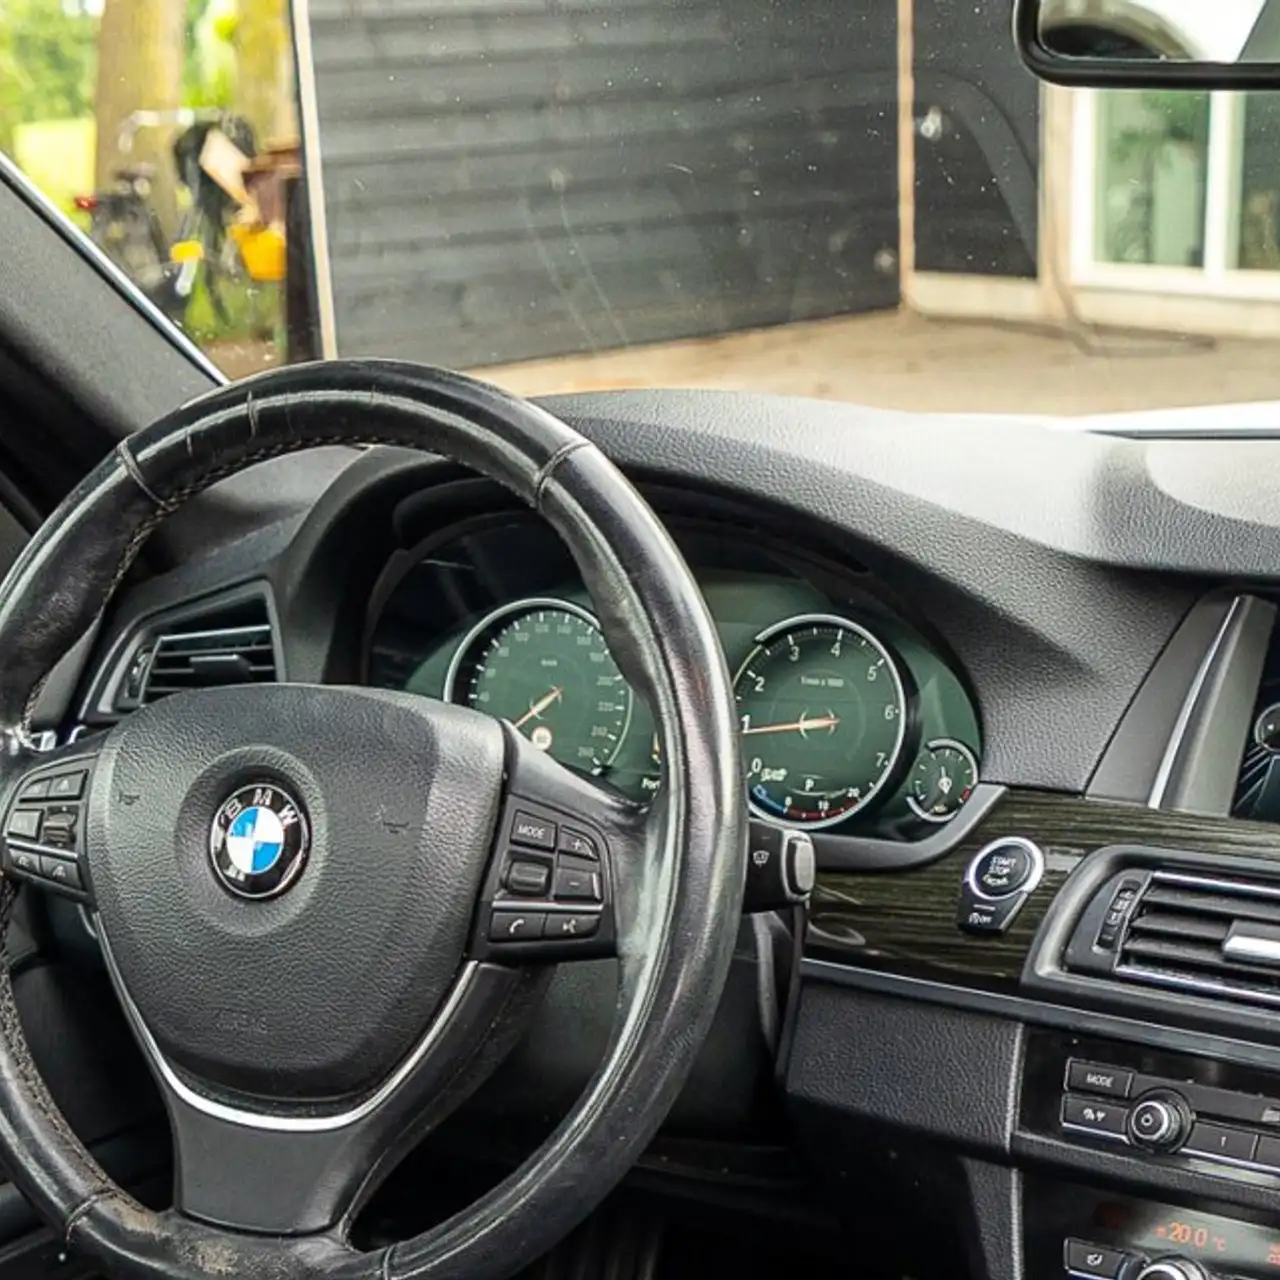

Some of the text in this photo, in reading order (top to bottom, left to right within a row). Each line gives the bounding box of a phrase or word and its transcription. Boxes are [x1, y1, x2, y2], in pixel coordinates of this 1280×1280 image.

[789, 647, 800, 662] 3
[831, 642, 841, 657] 4
[867, 666, 878, 681] 5
[754, 676, 765, 692] 2
[884, 704, 895, 720] 6
[741, 714, 751, 733] 1
[751, 757, 762, 773] 0
[876, 752, 886, 768] 7
[225, 788, 298, 826] BMW
[517, 823, 546, 840] MODE
[1086, 1072, 1115, 1088] MODE
[1171, 1223, 1208, 1247] 200
